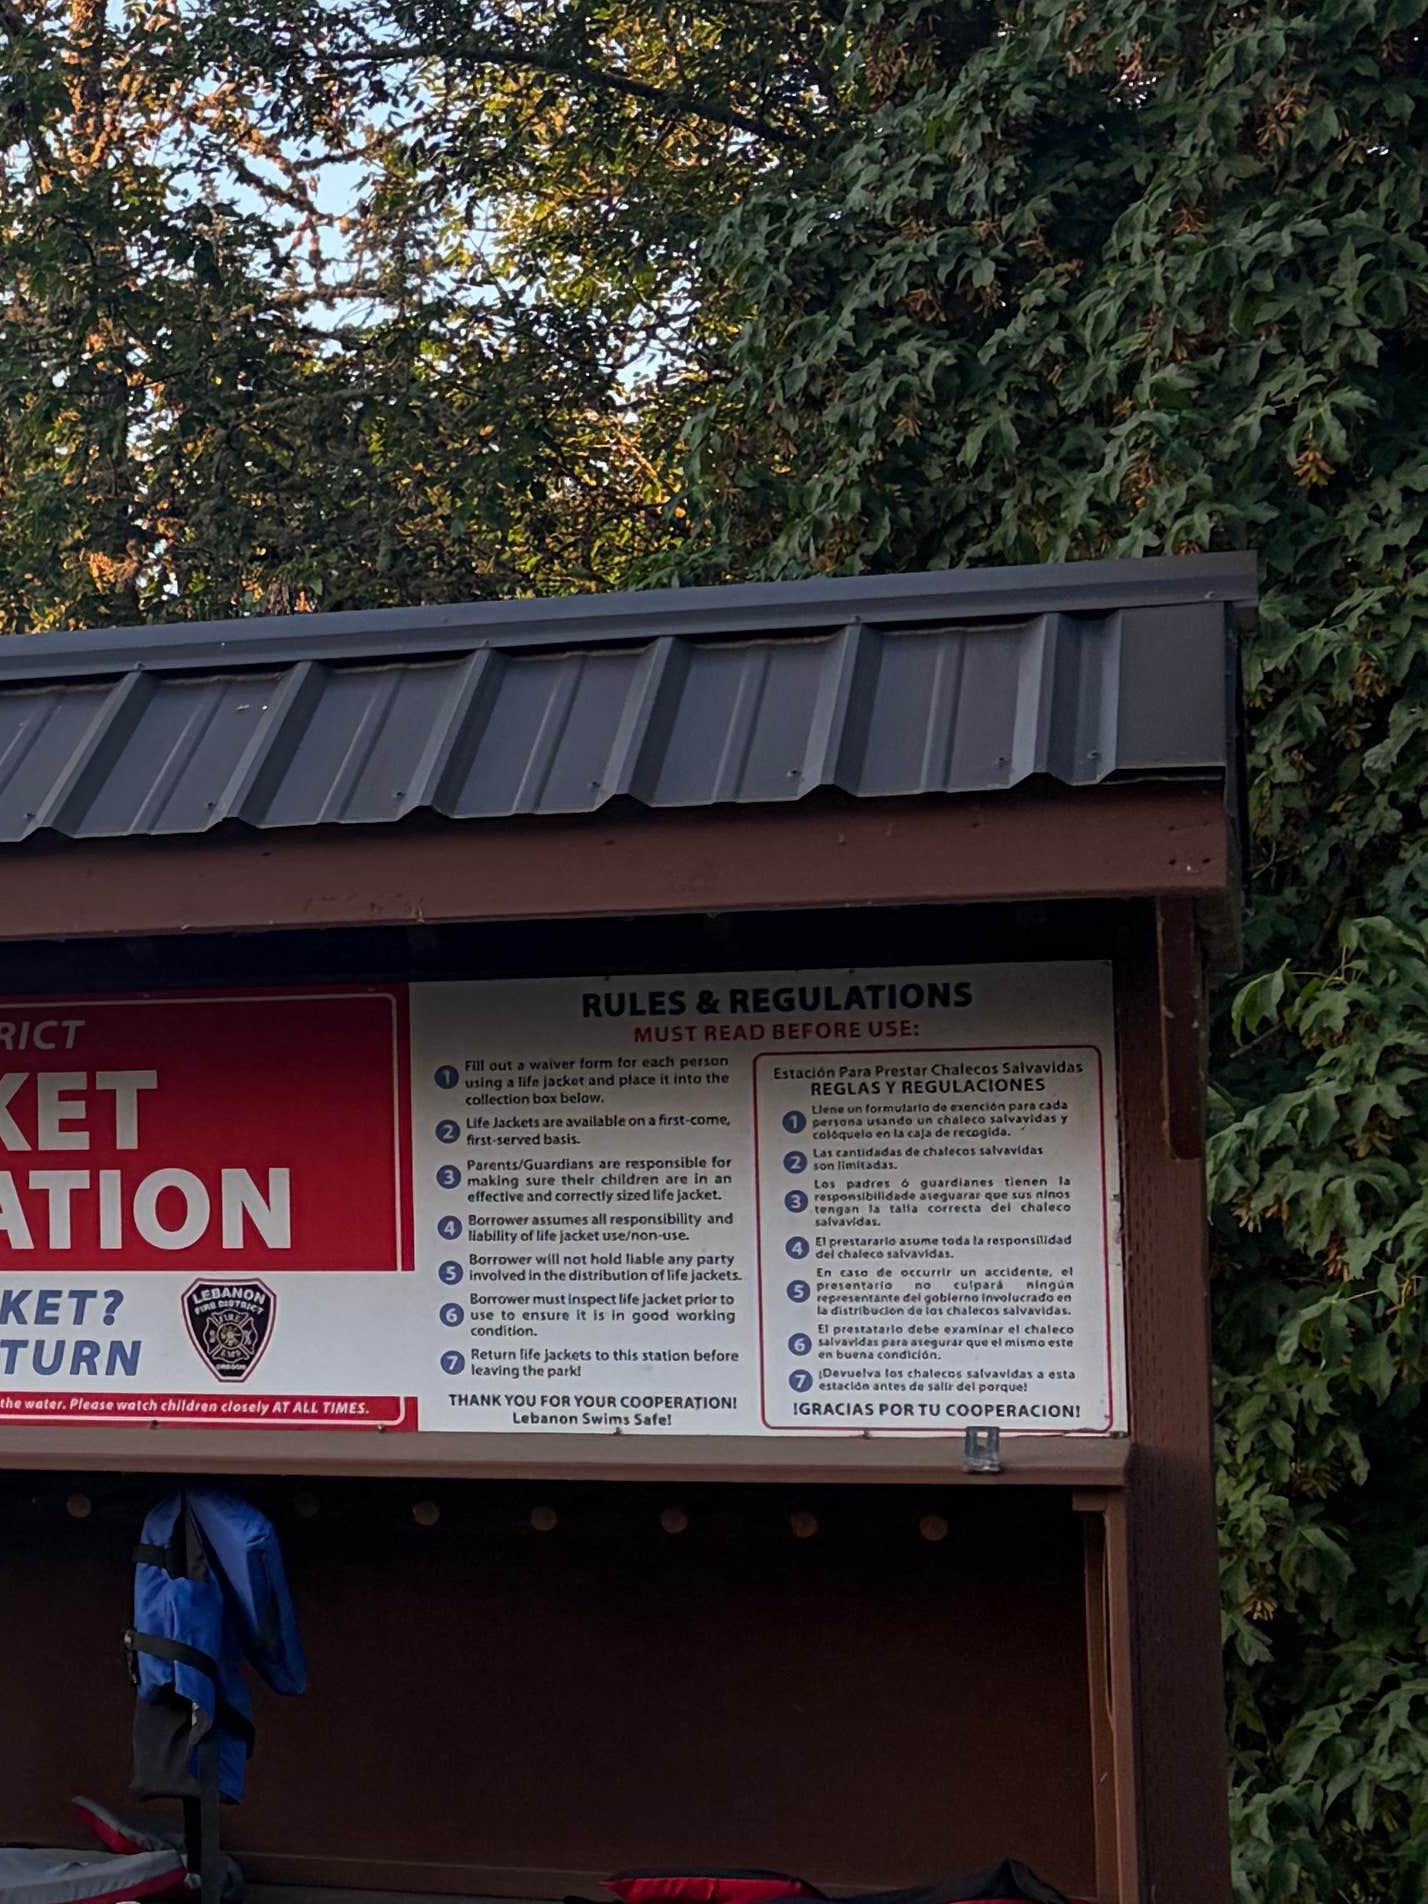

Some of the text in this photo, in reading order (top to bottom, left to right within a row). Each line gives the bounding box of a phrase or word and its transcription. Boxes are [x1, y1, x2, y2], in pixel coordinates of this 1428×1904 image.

[583, 982, 972, 1018] RULES & REGULATIONS
[634, 1020, 919, 1043] MUST READ BEFORE USE:
[774, 1061, 1083, 1080] Estación Para Prestar Chalecos Salvavidas
[811, 1078, 1045, 1096] REGLAS Y REGULACIONES
[192, 1287, 265, 1304] LEBANON
[471, 1348, 739, 1363] Return life jackets to this station before
[471, 1364, 581, 1379] leaving the park!
[0, 1397, 22, 1409] the
[25, 1399, 66, 1410] water.
[69, 1398, 114, 1410] Please
[116, 1399, 158, 1411] watch
[161, 1399, 217, 1412] children
[221, 1400, 269, 1416] closely
[272, 1401, 290, 1413] AT
[292, 1401, 318, 1414] ALL
[323, 1401, 369, 1414] TIMES.
[449, 1394, 737, 1409] THANK YOU FOR YOUR COOPERATION!
[513, 1412, 671, 1426] Lebanon Swims Safe!
[879, 1403, 914, 1416] POR
[919, 1403, 940, 1417] TU
[946, 1404, 1080, 1418] COOPERACION!
